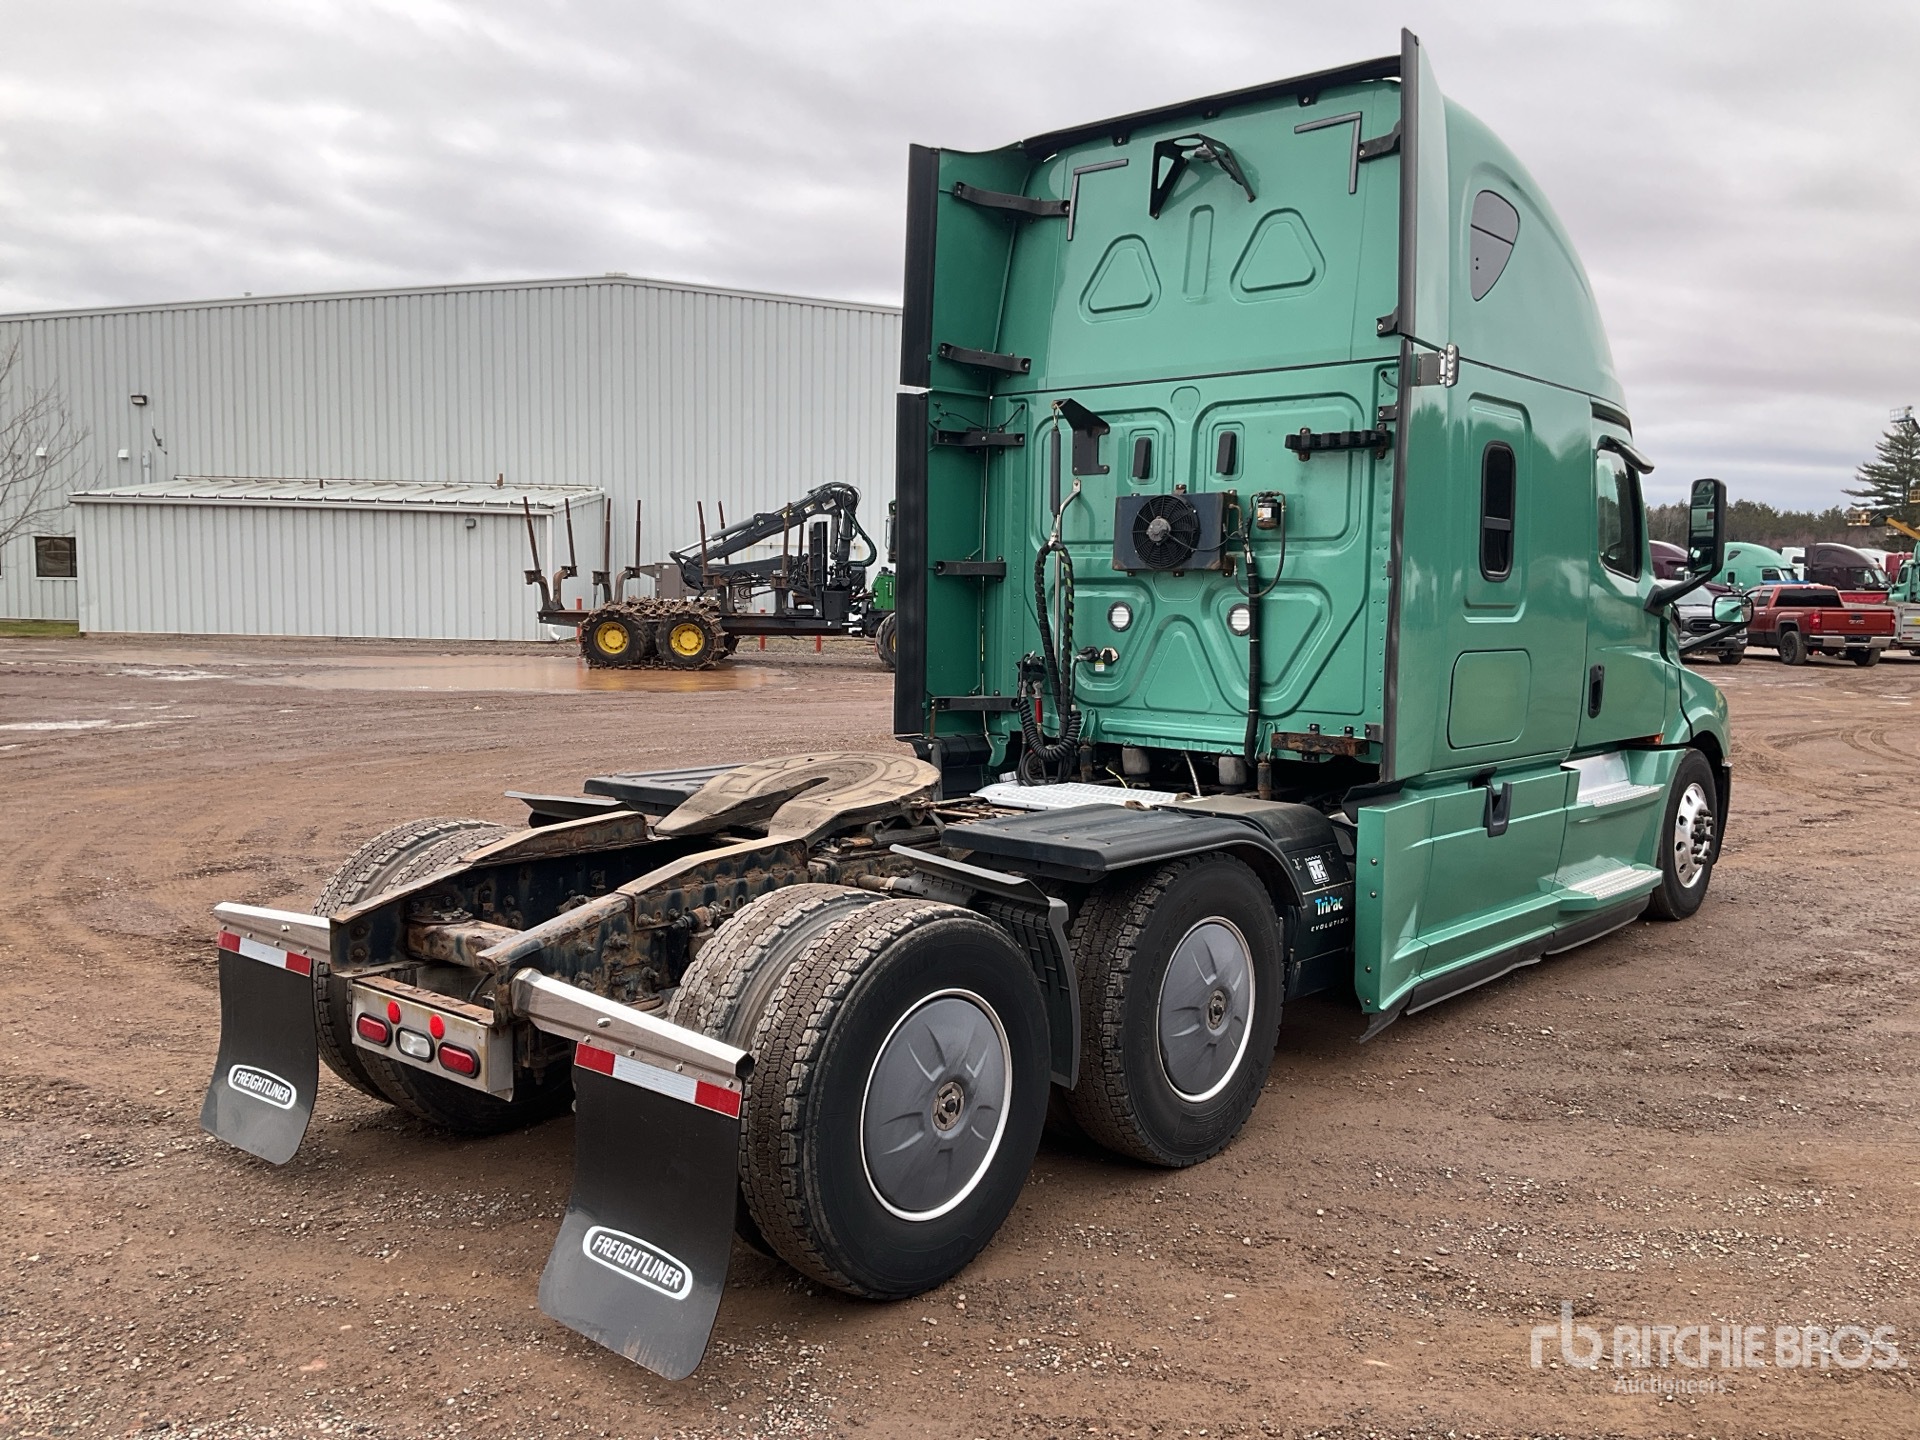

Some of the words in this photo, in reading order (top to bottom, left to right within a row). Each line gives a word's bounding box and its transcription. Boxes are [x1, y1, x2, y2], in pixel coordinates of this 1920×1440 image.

[1310, 917, 1349, 932] EVOLUTION
[233, 1070, 291, 1103] FREIGHTLINER
[591, 1234, 683, 1290] FREIGHTLINER
